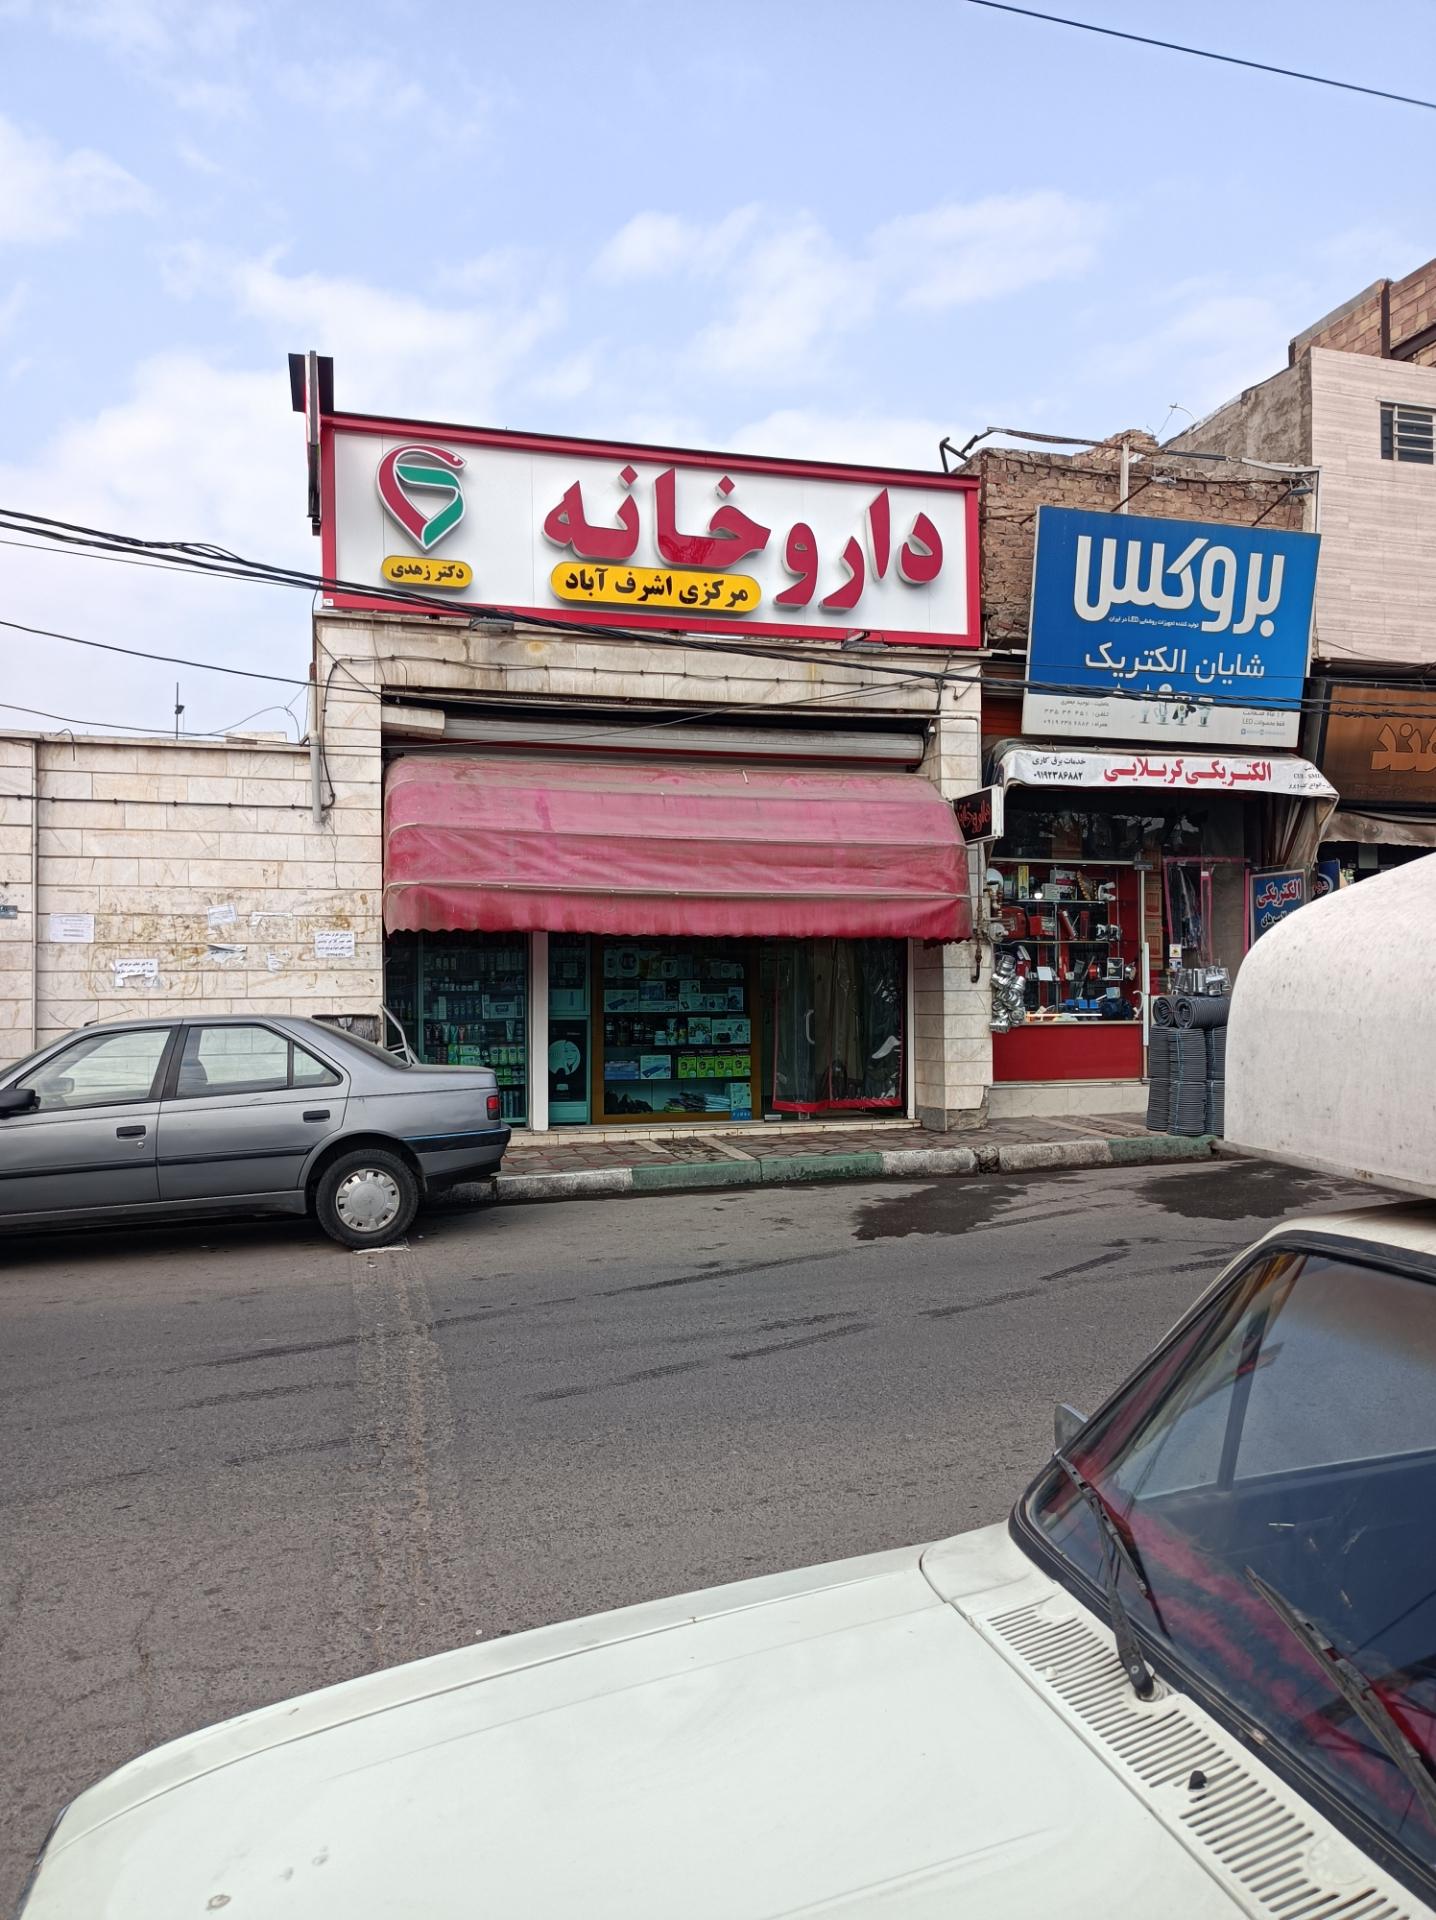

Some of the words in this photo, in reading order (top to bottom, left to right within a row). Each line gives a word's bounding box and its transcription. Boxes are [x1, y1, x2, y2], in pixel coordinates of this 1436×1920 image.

[542, 465, 943, 611] داروخانه
[391, 564, 431, 580] زهدی
[435, 565, 464, 581] دکتر
[564, 567, 608, 598] آباد
[1074, 534, 1286, 638] بروکس
[614, 572, 673, 603] اشرف
[679, 577, 749, 609] مرکزی
[1084, 641, 1187, 679] الکتریک
[1194, 653, 1265, 686] شایان
[1032, 756, 1050, 765] کاری
[1050, 756, 1063, 766] برق
[1063, 757, 1086, 766] خدمات
[1104, 756, 1184, 785] کربلایی
[1185, 759, 1272, 786] الکتریکی
[1257, 879, 1302, 909] الکتریکی
